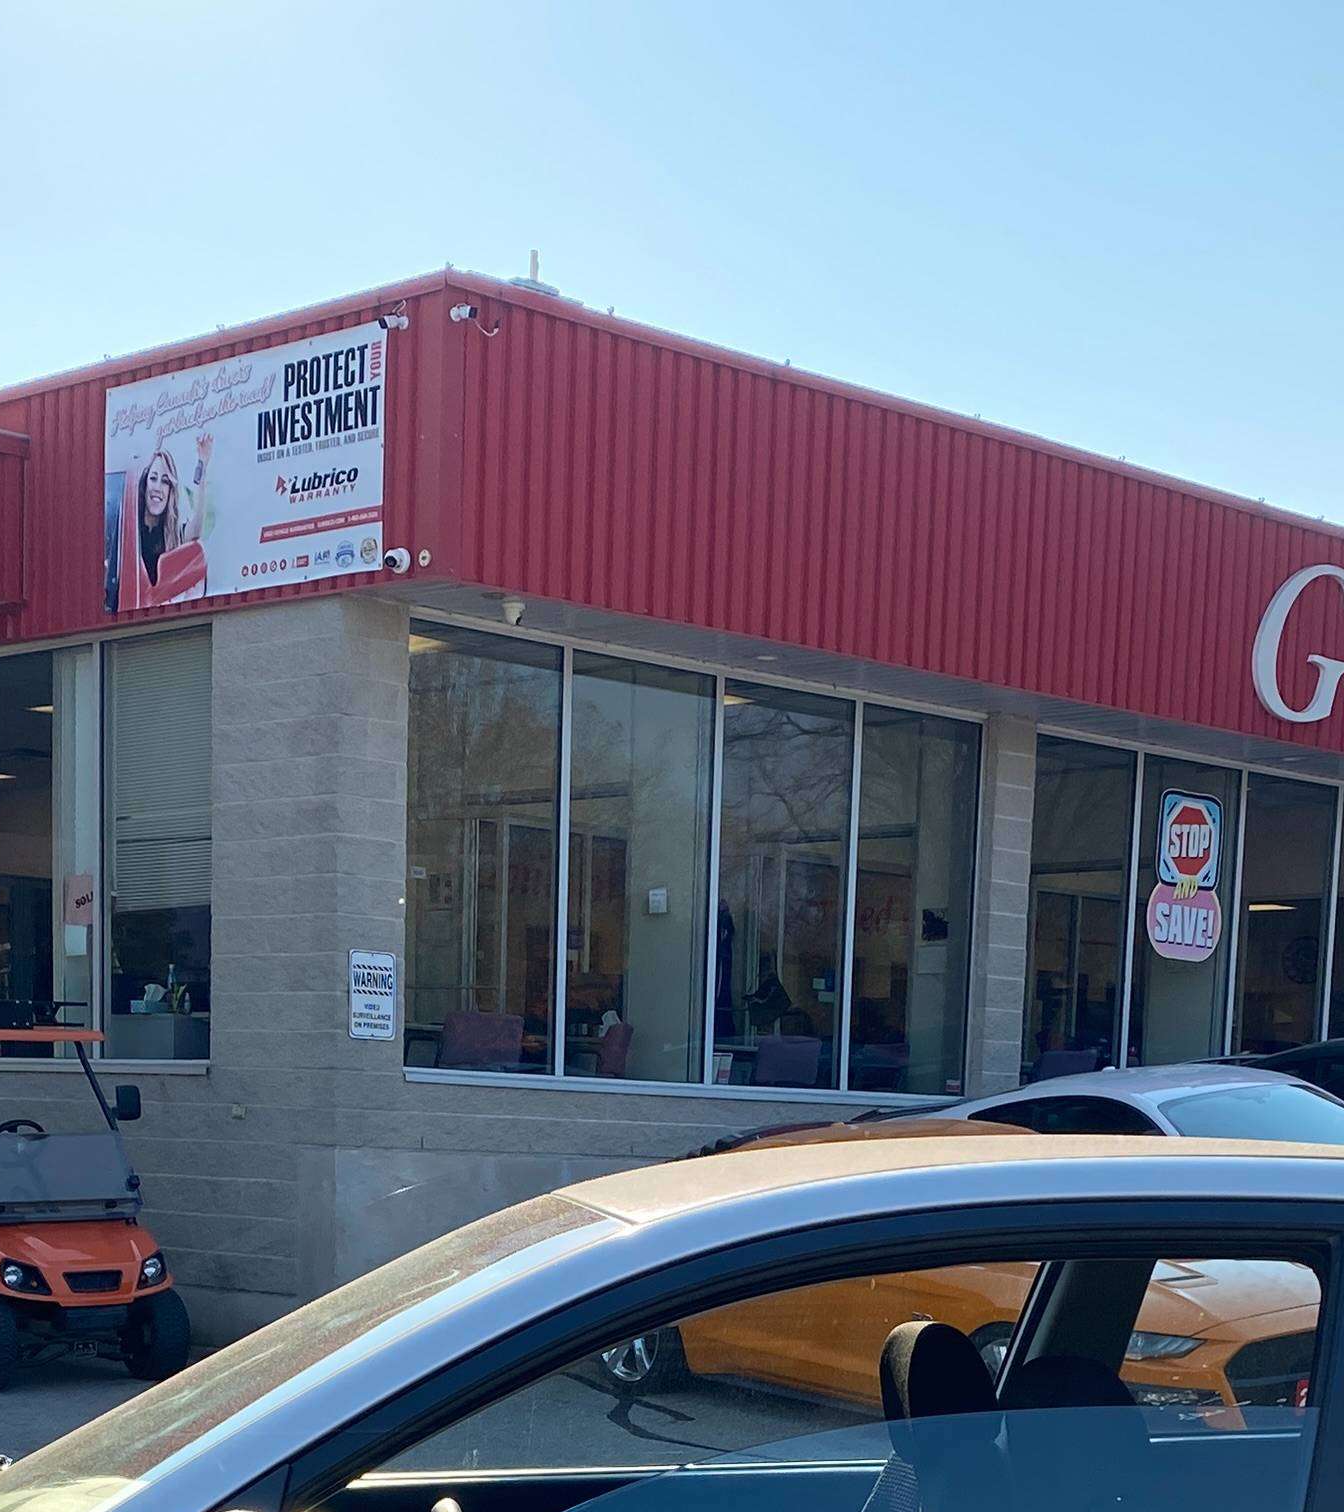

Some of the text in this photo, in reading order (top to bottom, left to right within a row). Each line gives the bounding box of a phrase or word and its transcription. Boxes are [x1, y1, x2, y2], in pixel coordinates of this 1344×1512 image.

[284, 344, 368, 402] PROTECT
[370, 341, 382, 381] YOUR
[257, 385, 381, 450] INVESTMENT
[289, 467, 359, 495] Lubrico
[289, 483, 357, 505] WARRANTY
[1170, 823, 1211, 858] STOP
[1173, 877, 1198, 900] AND
[1155, 902, 1215, 950] SAVE!
[353, 971, 393, 990] WARNING
